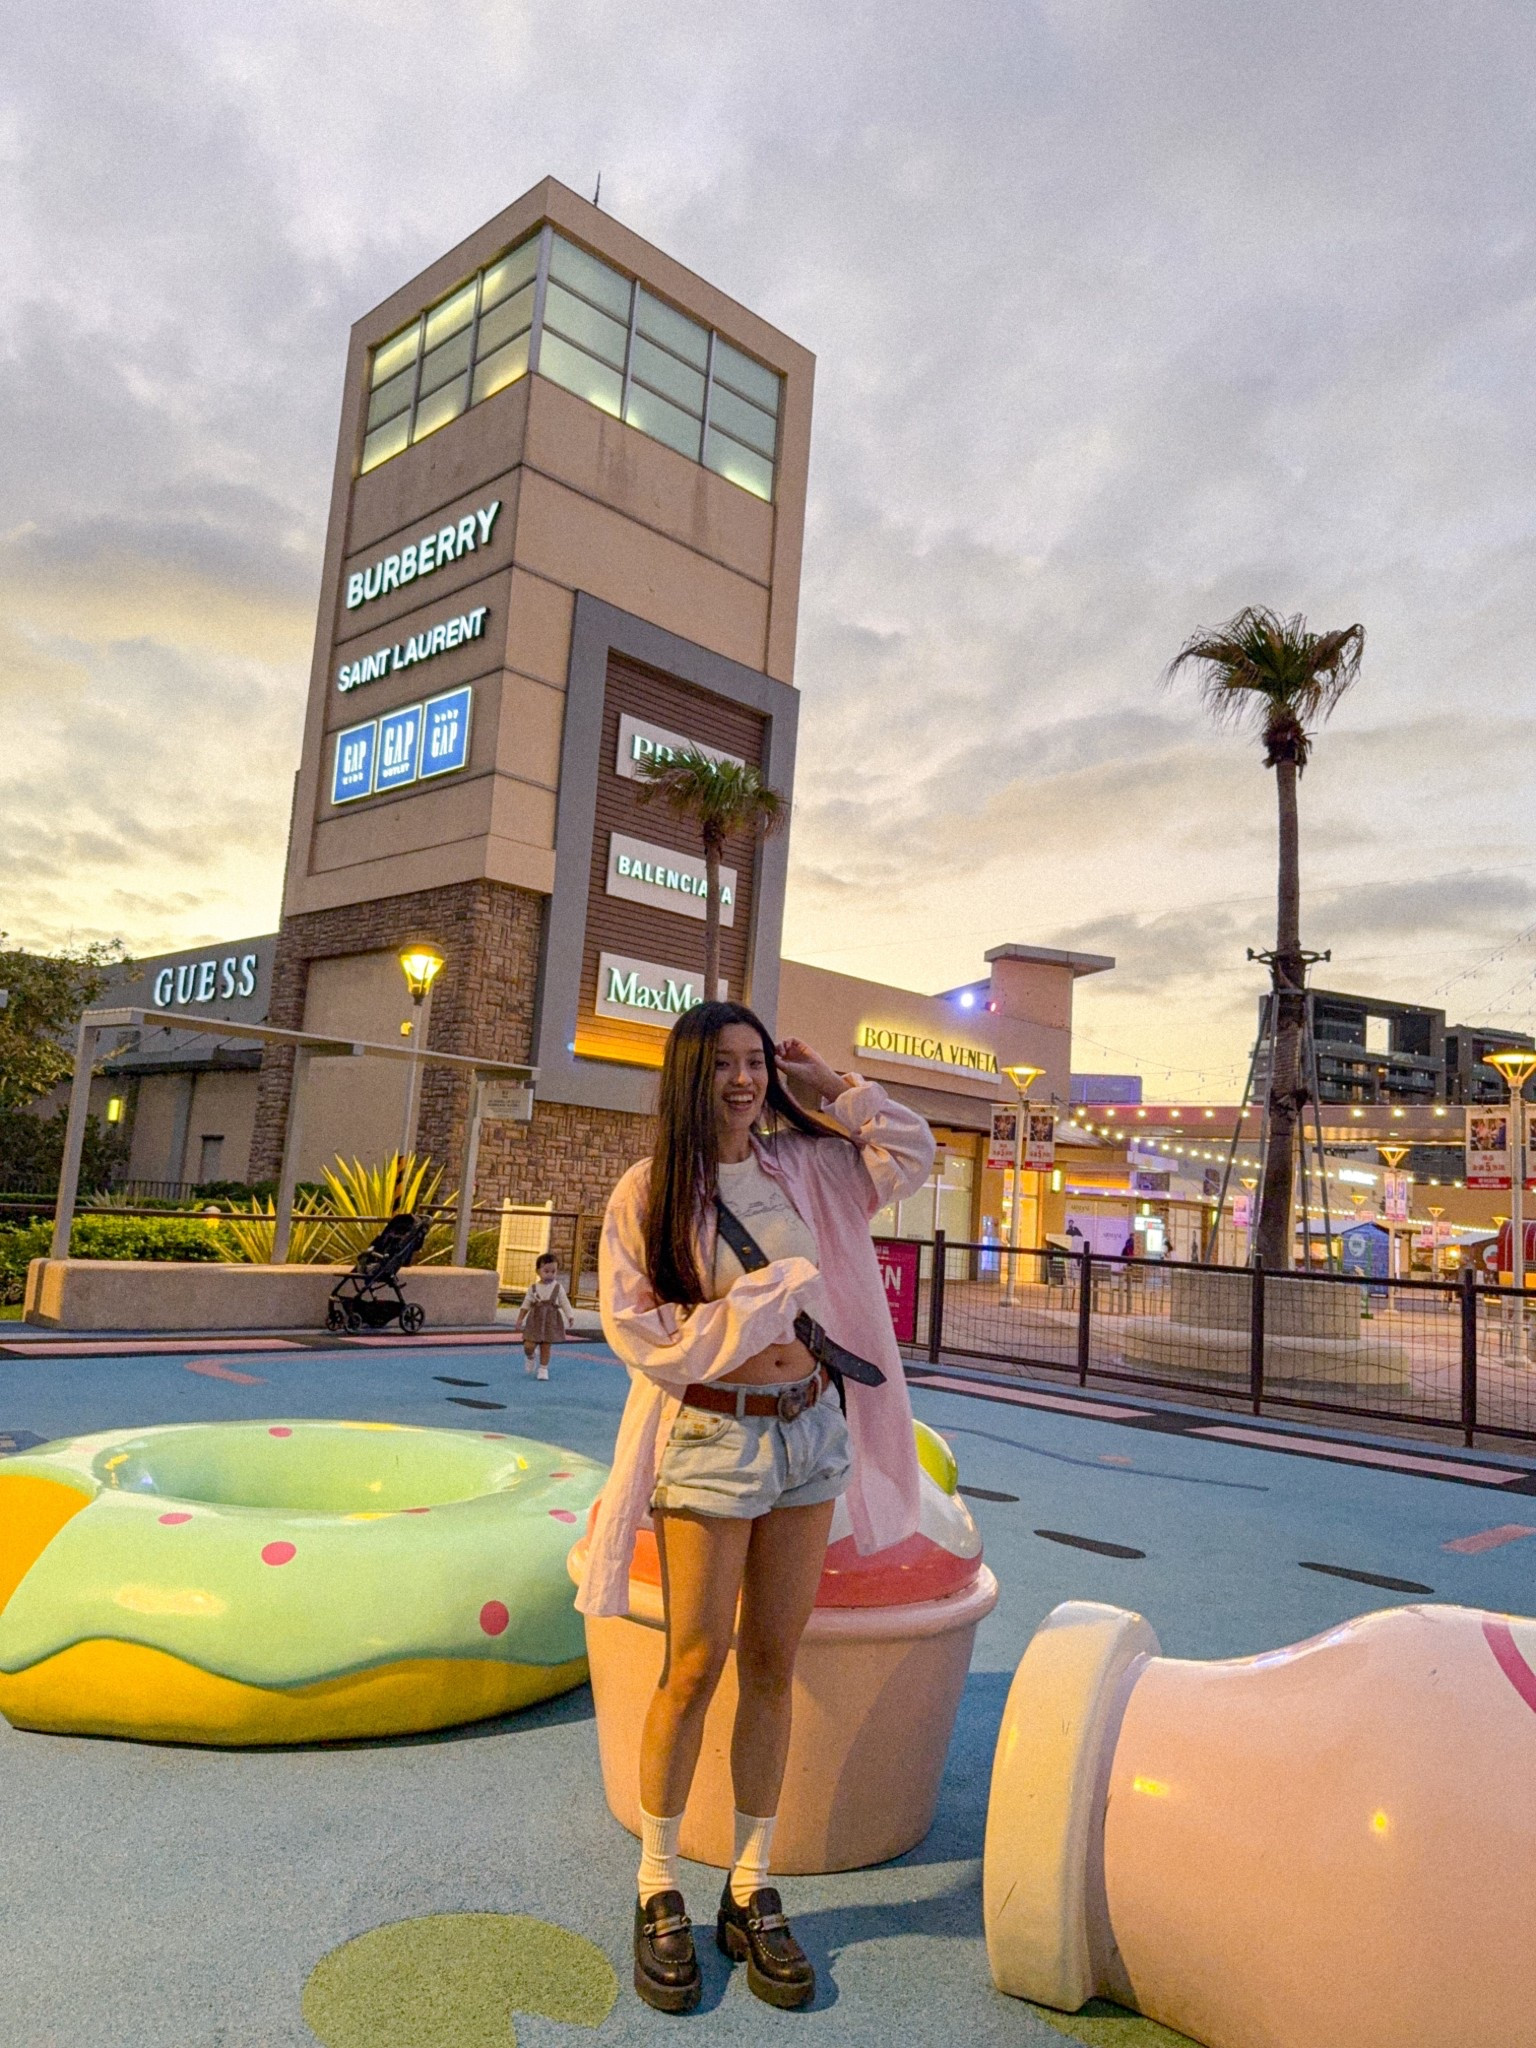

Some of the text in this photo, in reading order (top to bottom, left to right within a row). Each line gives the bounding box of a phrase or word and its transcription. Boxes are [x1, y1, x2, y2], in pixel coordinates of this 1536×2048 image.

[346, 501, 500, 609] BURBERRY
[337, 606, 487, 692] SAINT LAURENT
[343, 740, 367, 774] GAP
[383, 721, 414, 767] GAP
[431, 722, 458, 758] GAP
[382, 762, 410, 778] OUTLET
[618, 855, 732, 905] BALENCIAA
[154, 954, 256, 1007] GUESS
[865, 1027, 999, 1074] BOTTEGA VENETA
